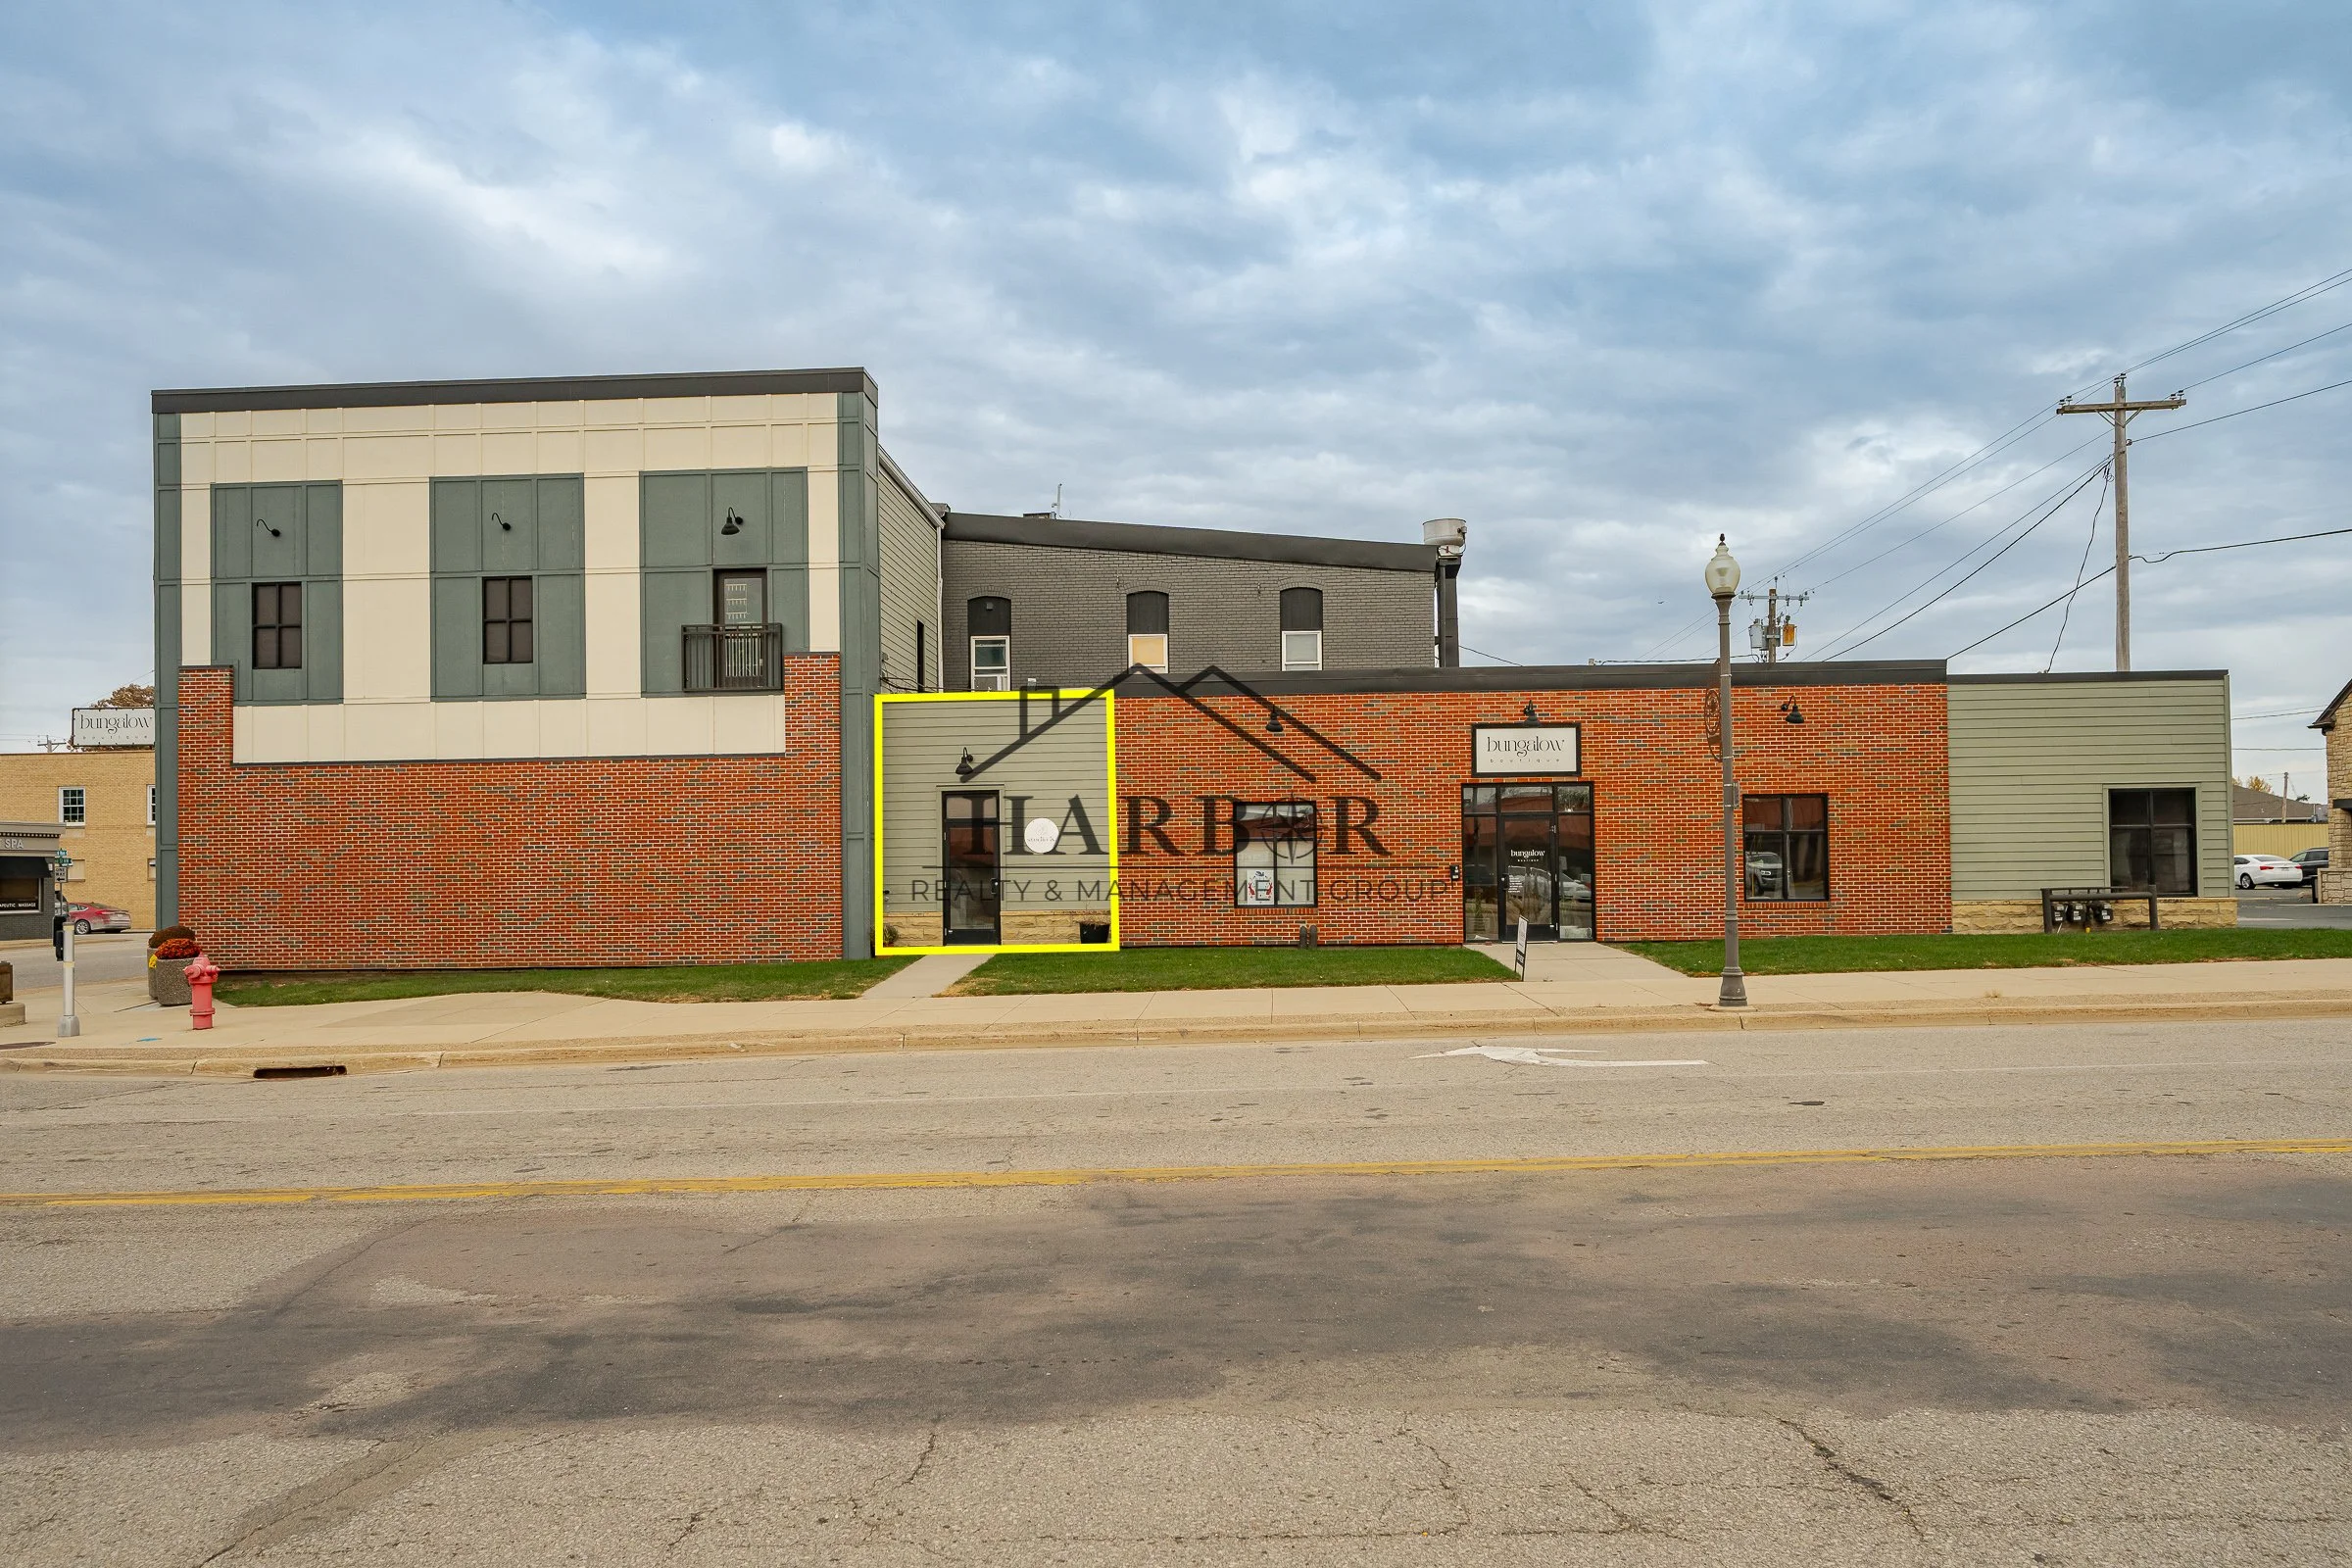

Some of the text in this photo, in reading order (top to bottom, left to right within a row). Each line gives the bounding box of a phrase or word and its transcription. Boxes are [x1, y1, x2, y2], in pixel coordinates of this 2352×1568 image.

[80, 713, 152, 734] bungalow
[1488, 736, 1565, 758] bungalow
[5, 839, 24, 849] SPA
[1510, 849, 1545, 858] bungalow
